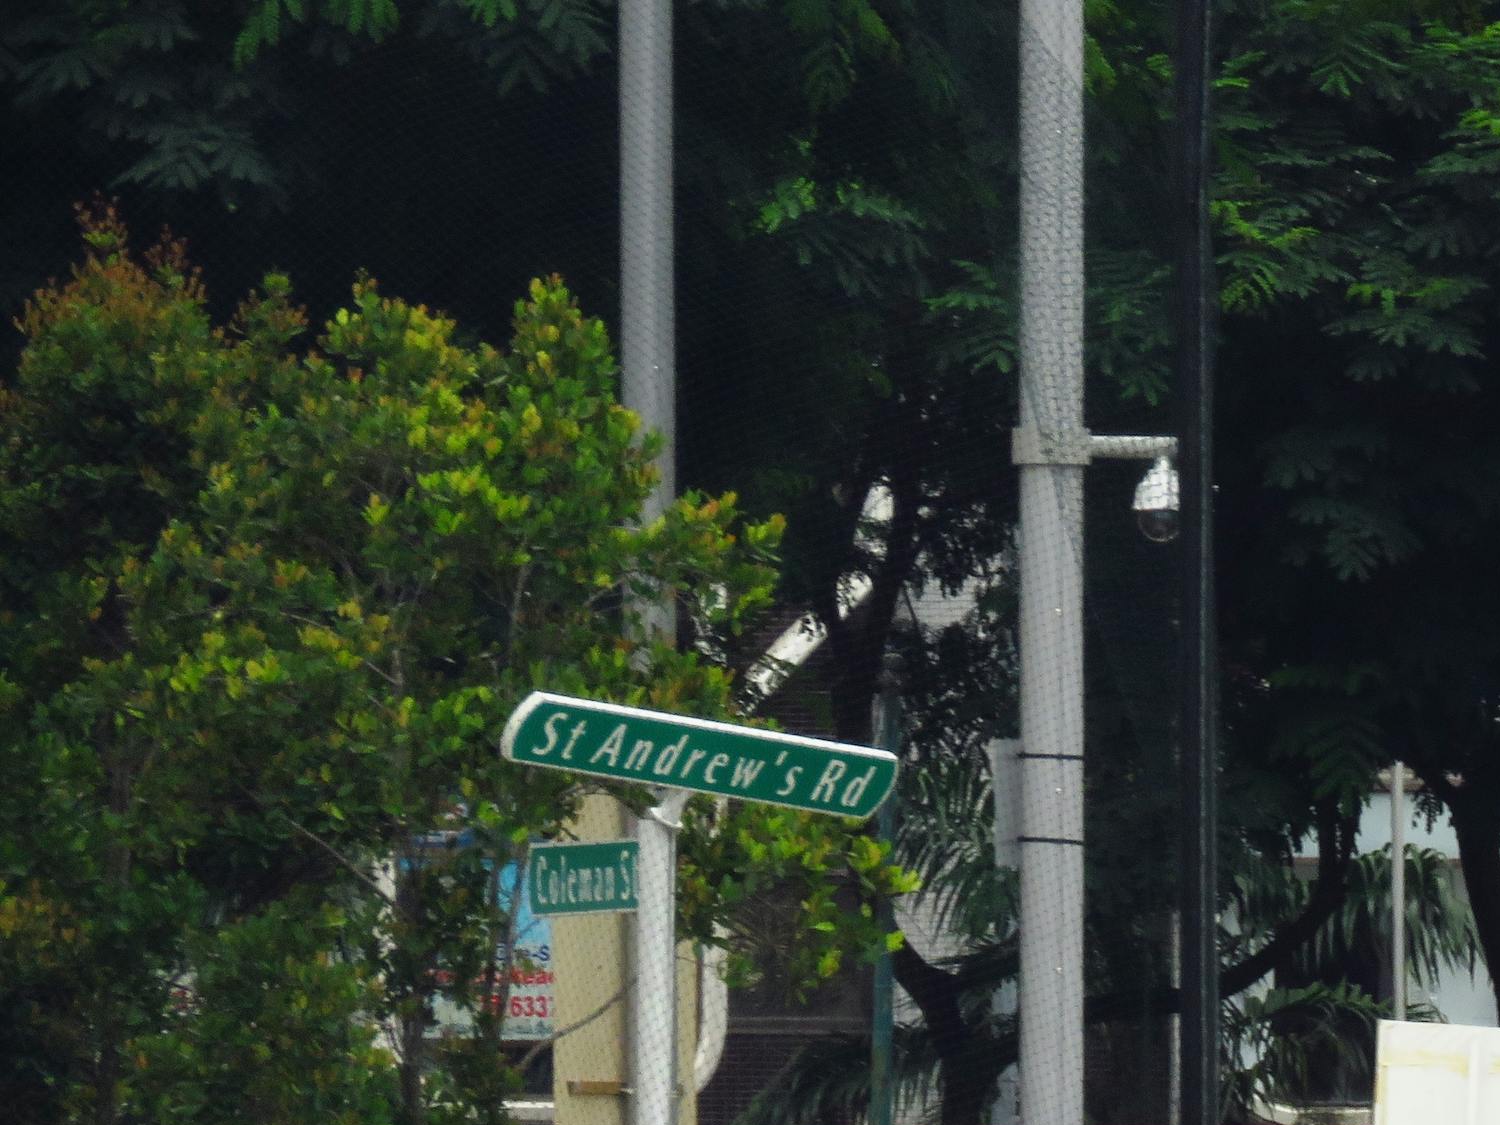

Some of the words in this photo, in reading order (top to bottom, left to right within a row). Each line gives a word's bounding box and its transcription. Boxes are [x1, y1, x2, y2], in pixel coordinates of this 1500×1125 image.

[532, 711, 587, 761] St
[589, 723, 804, 797] Andrew's
[810, 758, 878, 808] Rd
[536, 854, 616, 905] Coleman
[511, 995, 553, 1018] 633
